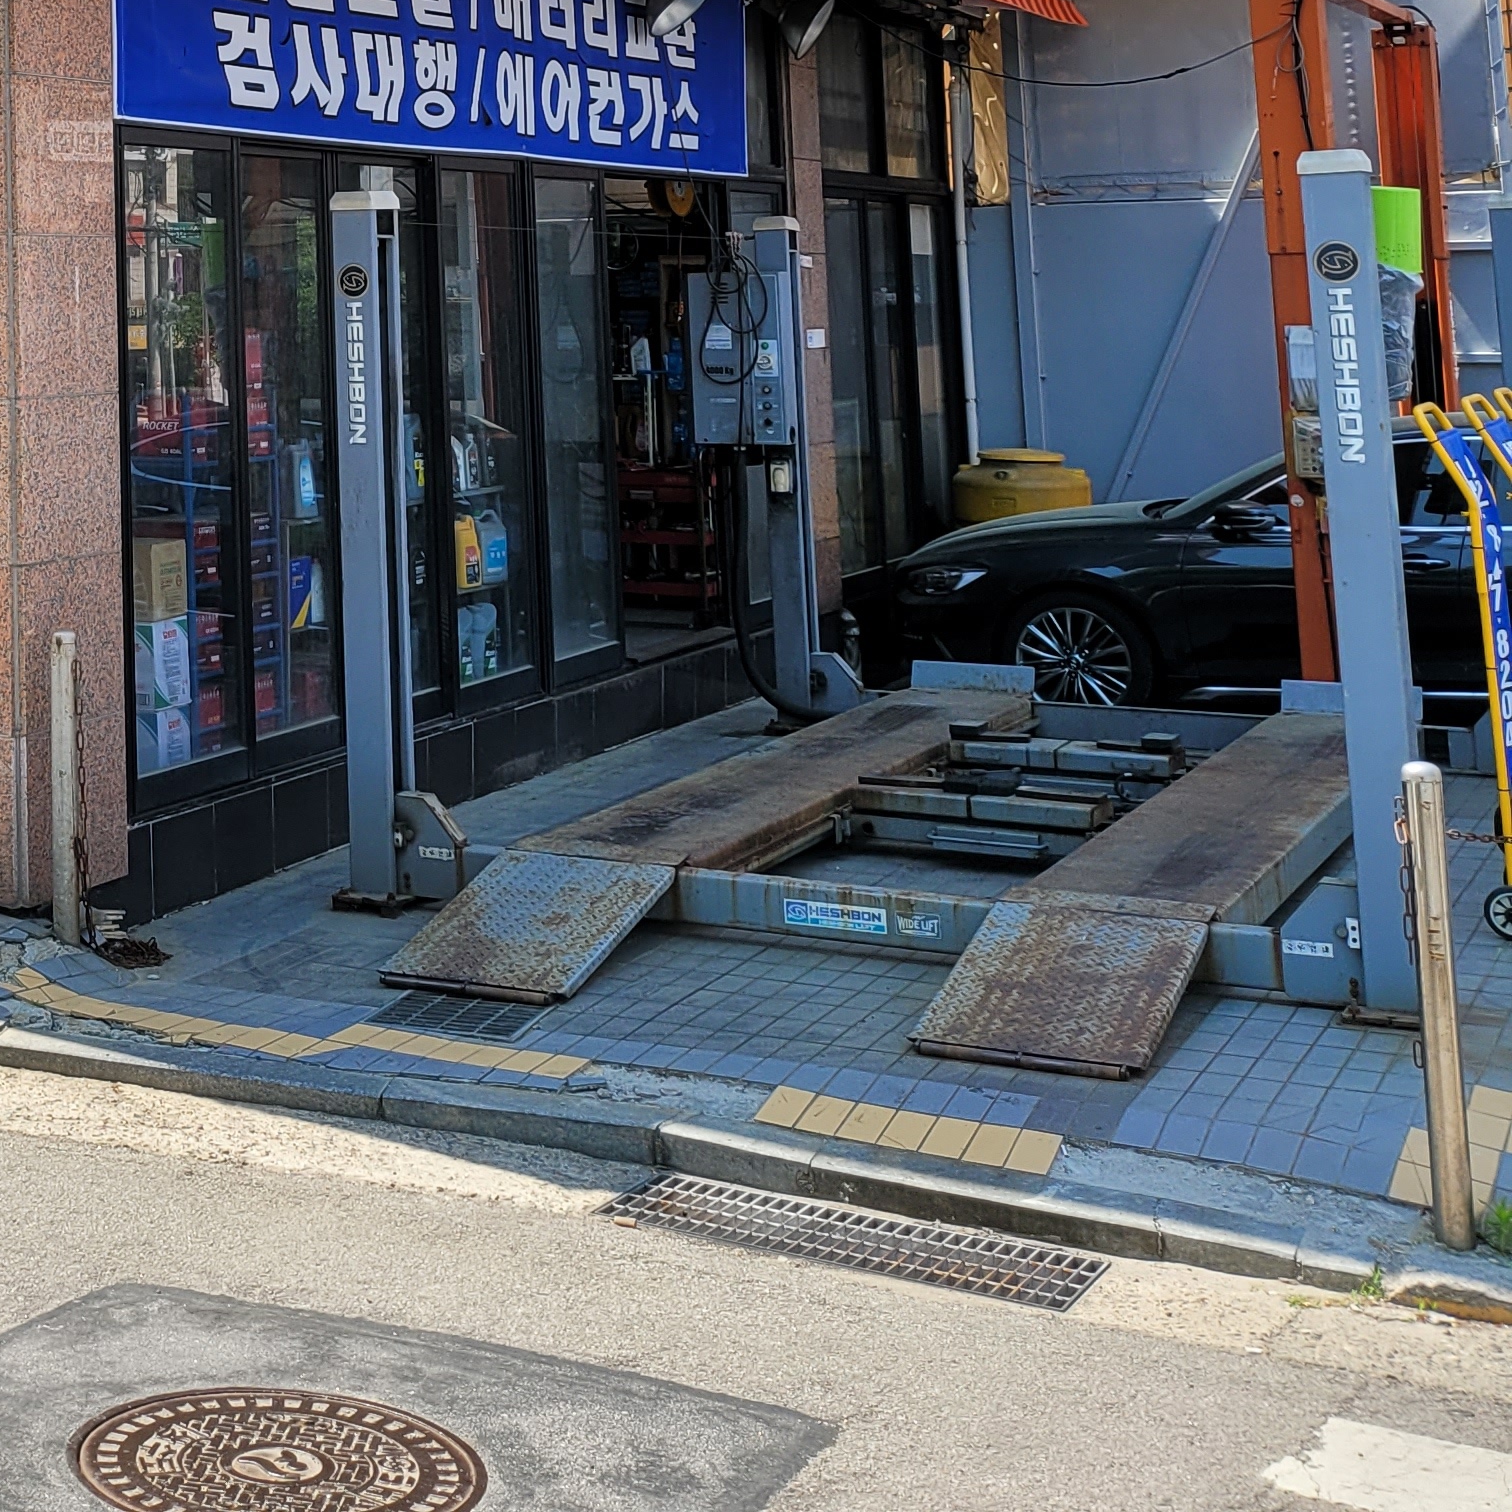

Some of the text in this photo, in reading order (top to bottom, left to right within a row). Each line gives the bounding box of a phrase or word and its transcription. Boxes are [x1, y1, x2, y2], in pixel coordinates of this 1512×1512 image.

[345, 300, 367, 445] HESHBON
[1328, 287, 1366, 464] HESHBON
[142, 420, 180, 431] ROCKET
[808, 905, 882, 923] HESHBON
[896, 914, 939, 933] WIDE LIFT
